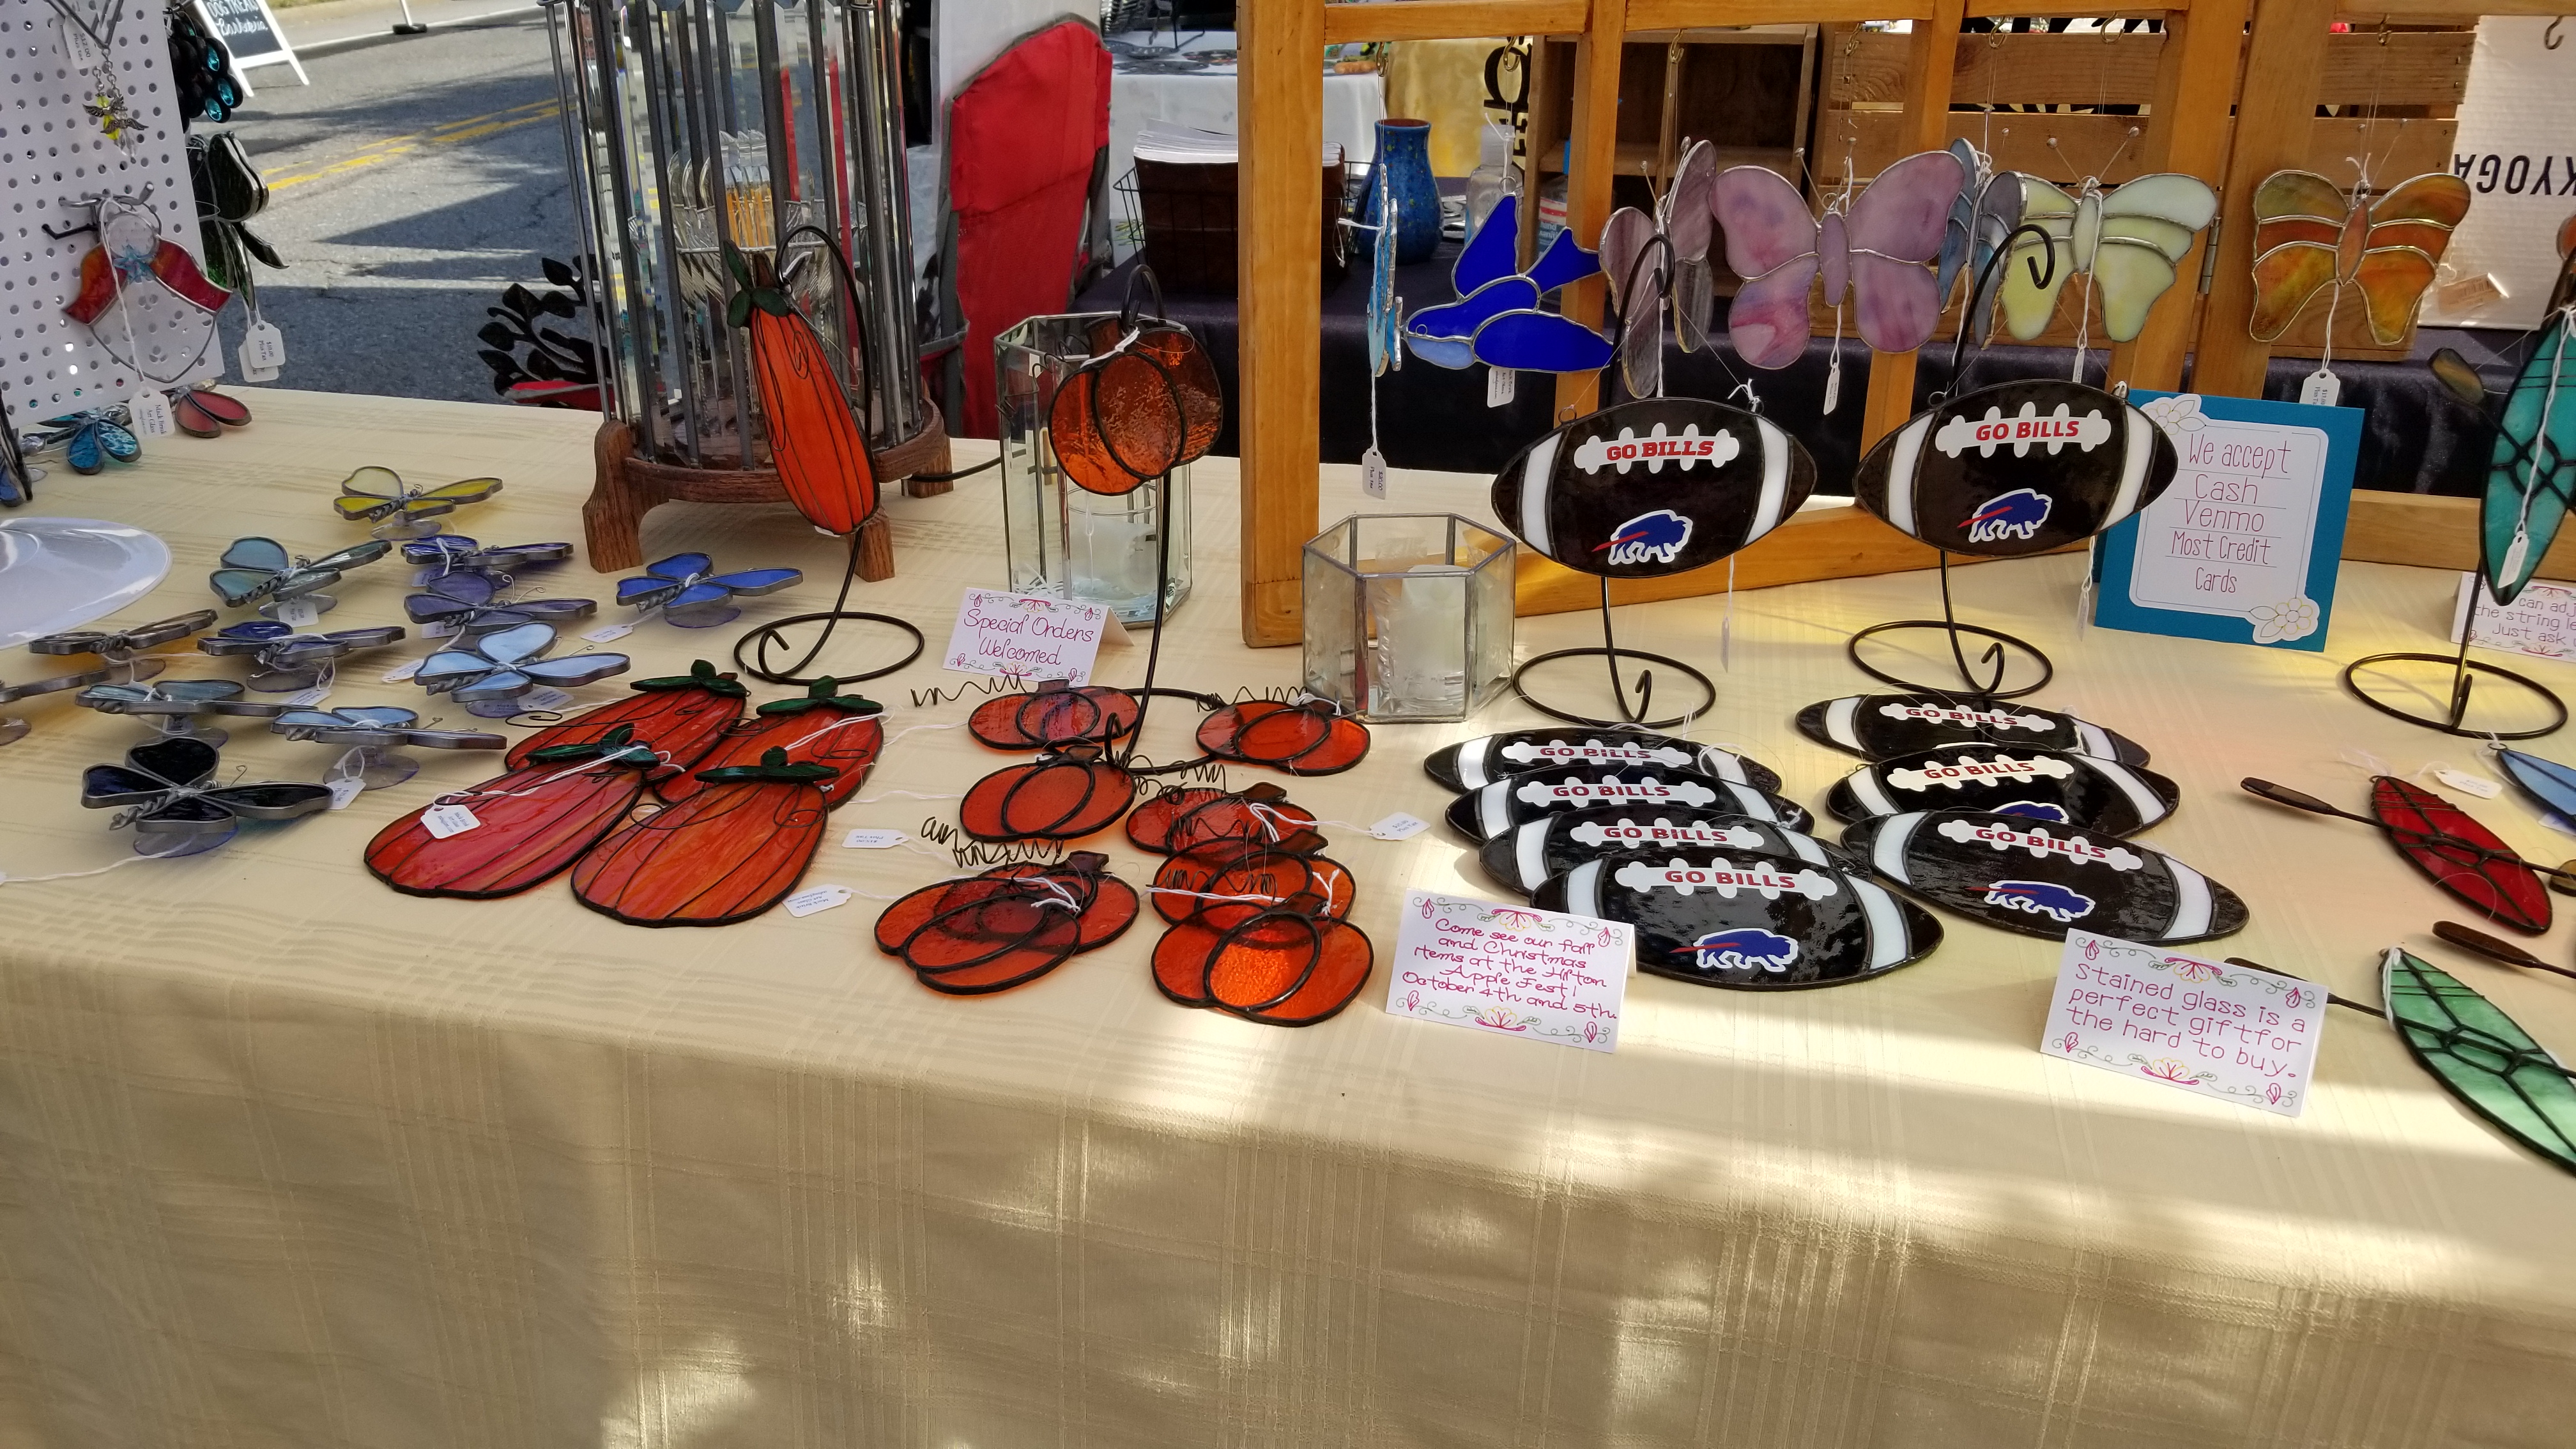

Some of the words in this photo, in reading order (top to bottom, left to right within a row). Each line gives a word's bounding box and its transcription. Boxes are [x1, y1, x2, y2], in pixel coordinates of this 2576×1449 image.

[1975, 423, 2009, 441] GO
[2016, 420, 2080, 439] BILLS
[1606, 443, 1637, 461] GO
[1641, 440, 1715, 458] BILLS
[2188, 433, 2214, 464] We
[2221, 440, 2292, 479] accept
[2195, 474, 2258, 503] Cash
[2185, 499, 2264, 532] Venmo
[2171, 531, 2214, 560] Most
[2220, 536, 2271, 565] Credit
[2195, 567, 2237, 594] Cards
[2518, 597, 2543, 610] can
[964, 608, 1029, 638] Special
[1032, 617, 1094, 642] Orders
[2492, 623, 2532, 640] Just
[2538, 632, 2566, 646] ask
[2506, 611, 2561, 631] string
[979, 636, 1061, 665] Welcomed
[1905, 707, 1941, 719] GO
[1949, 710, 2018, 726] BILLS
[1540, 746, 1575, 756] GO
[1583, 747, 1652, 760] BILLS
[1923, 765, 1959, 779] GO
[1968, 762, 2035, 777] BILLS
[1552, 785, 1590, 797] GO
[1598, 785, 1671, 797] BILLS
[1604, 827, 1642, 839] GO
[1651, 827, 1728, 842] BILLS
[1975, 828, 2017, 843] GO
[2026, 834, 2106, 859] BILLS
[1665, 870, 1706, 884] GO
[1715, 871, 1796, 889] BILLS
[1436, 918, 1484, 937] Come
[1490, 931, 1518, 942] see
[1524, 937, 1552, 947] our
[1558, 939, 1595, 954] fall
[1438, 938, 1478, 950] and
[1483, 941, 1586, 968] Christmas
[1439, 965, 1510, 988] Apple
[1469, 955, 1494, 970] at
[1499, 958, 1537, 974] the
[1542, 967, 1607, 987] Hilton
[1402, 971, 1474, 993] October
[1479, 987, 1521, 1002] 4th
[1527, 996, 1567, 1010] and
[1573, 1003, 1617, 1018] 5th.
[2068, 988, 2179, 1026] perfect
[2075, 963, 2174, 1000] Stained
[2182, 990, 2246, 1018] glass
[2258, 1006, 2280, 1025] is
[2292, 1018, 2305, 1033] a
[2066, 1006, 2112, 1031] the
[2122, 1019, 2181, 1048] hard
[2193, 1038, 2225, 1059] to
[2235, 1047, 2296, 1078] buy.
